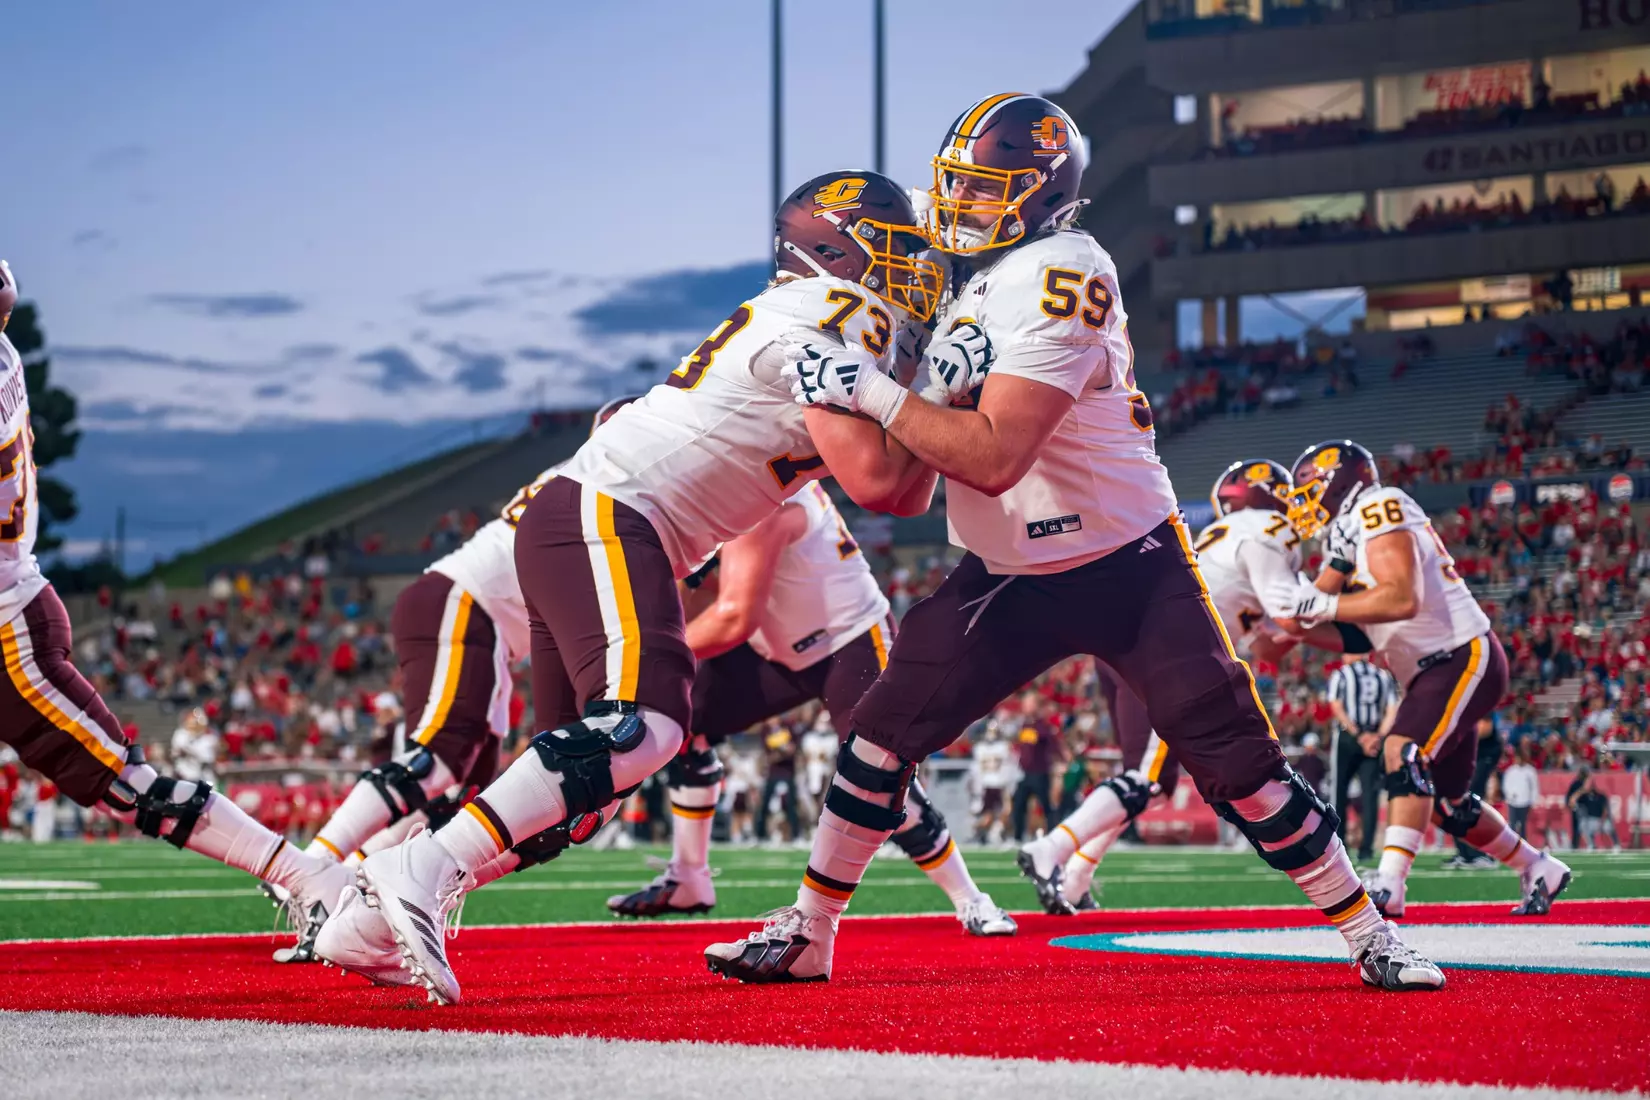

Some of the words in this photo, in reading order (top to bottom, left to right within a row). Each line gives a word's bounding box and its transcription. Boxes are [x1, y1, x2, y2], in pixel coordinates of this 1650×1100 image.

[1460, 130, 1647, 171] SANTIAGO
[819, 287, 893, 357] 73
[1040, 266, 1114, 331] 59
[1360, 499, 1405, 531] 56
